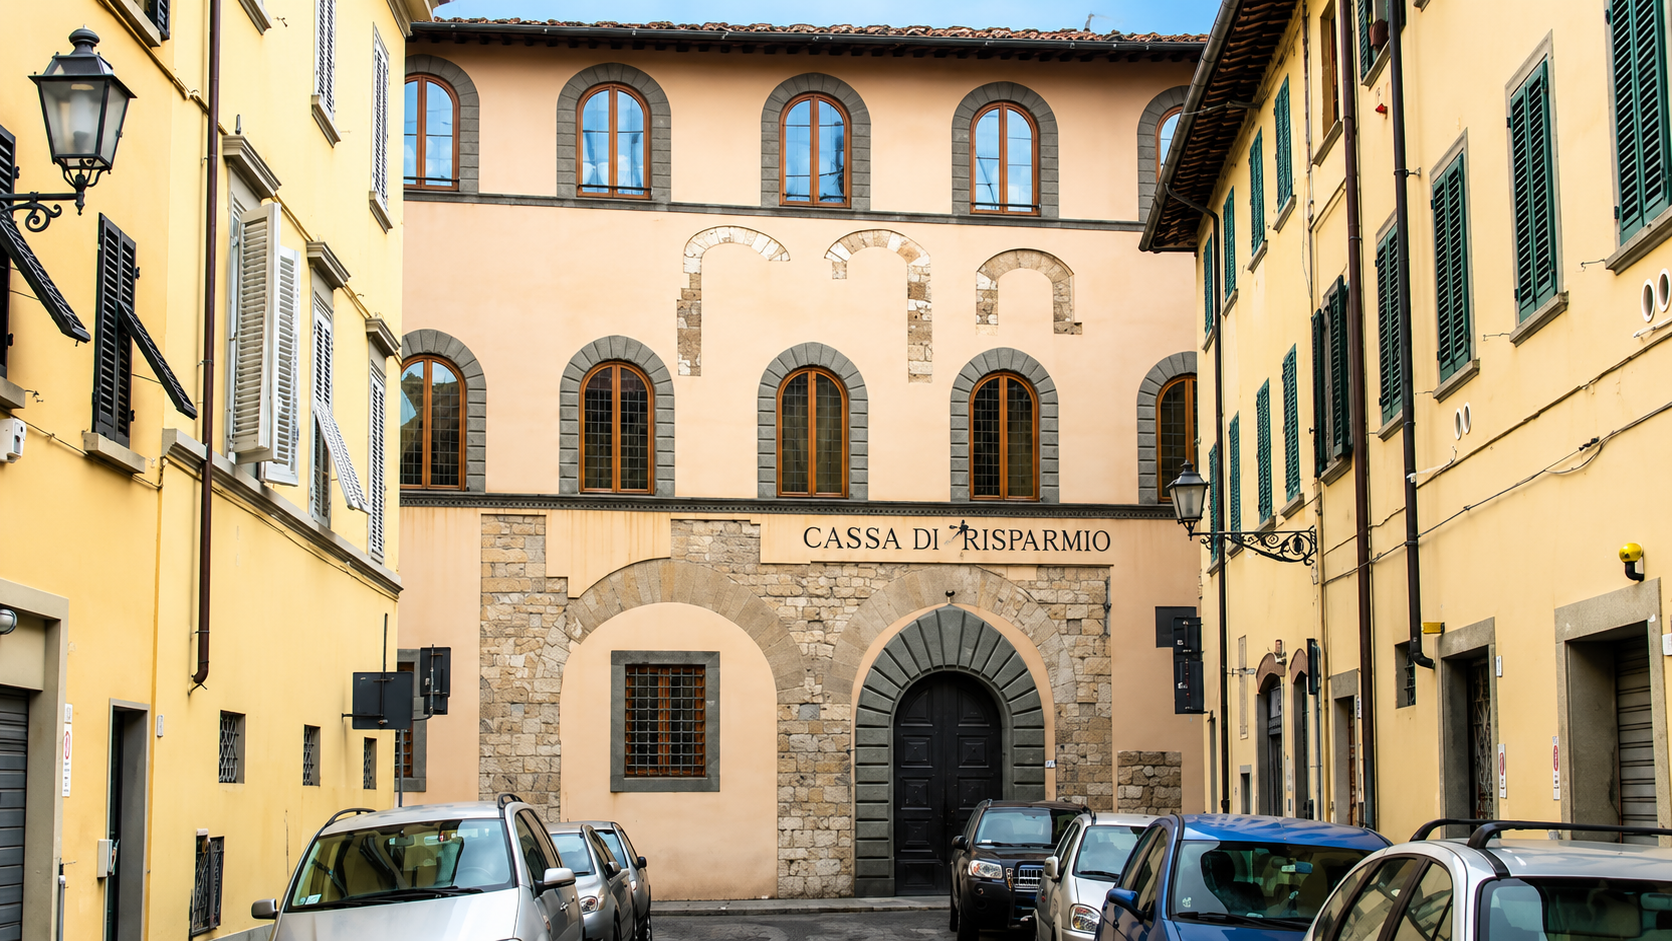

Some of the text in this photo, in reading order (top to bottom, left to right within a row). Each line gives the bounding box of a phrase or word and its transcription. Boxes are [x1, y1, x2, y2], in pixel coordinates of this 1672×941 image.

[803, 526, 1112, 552] CASSA DI RISPARMIO
